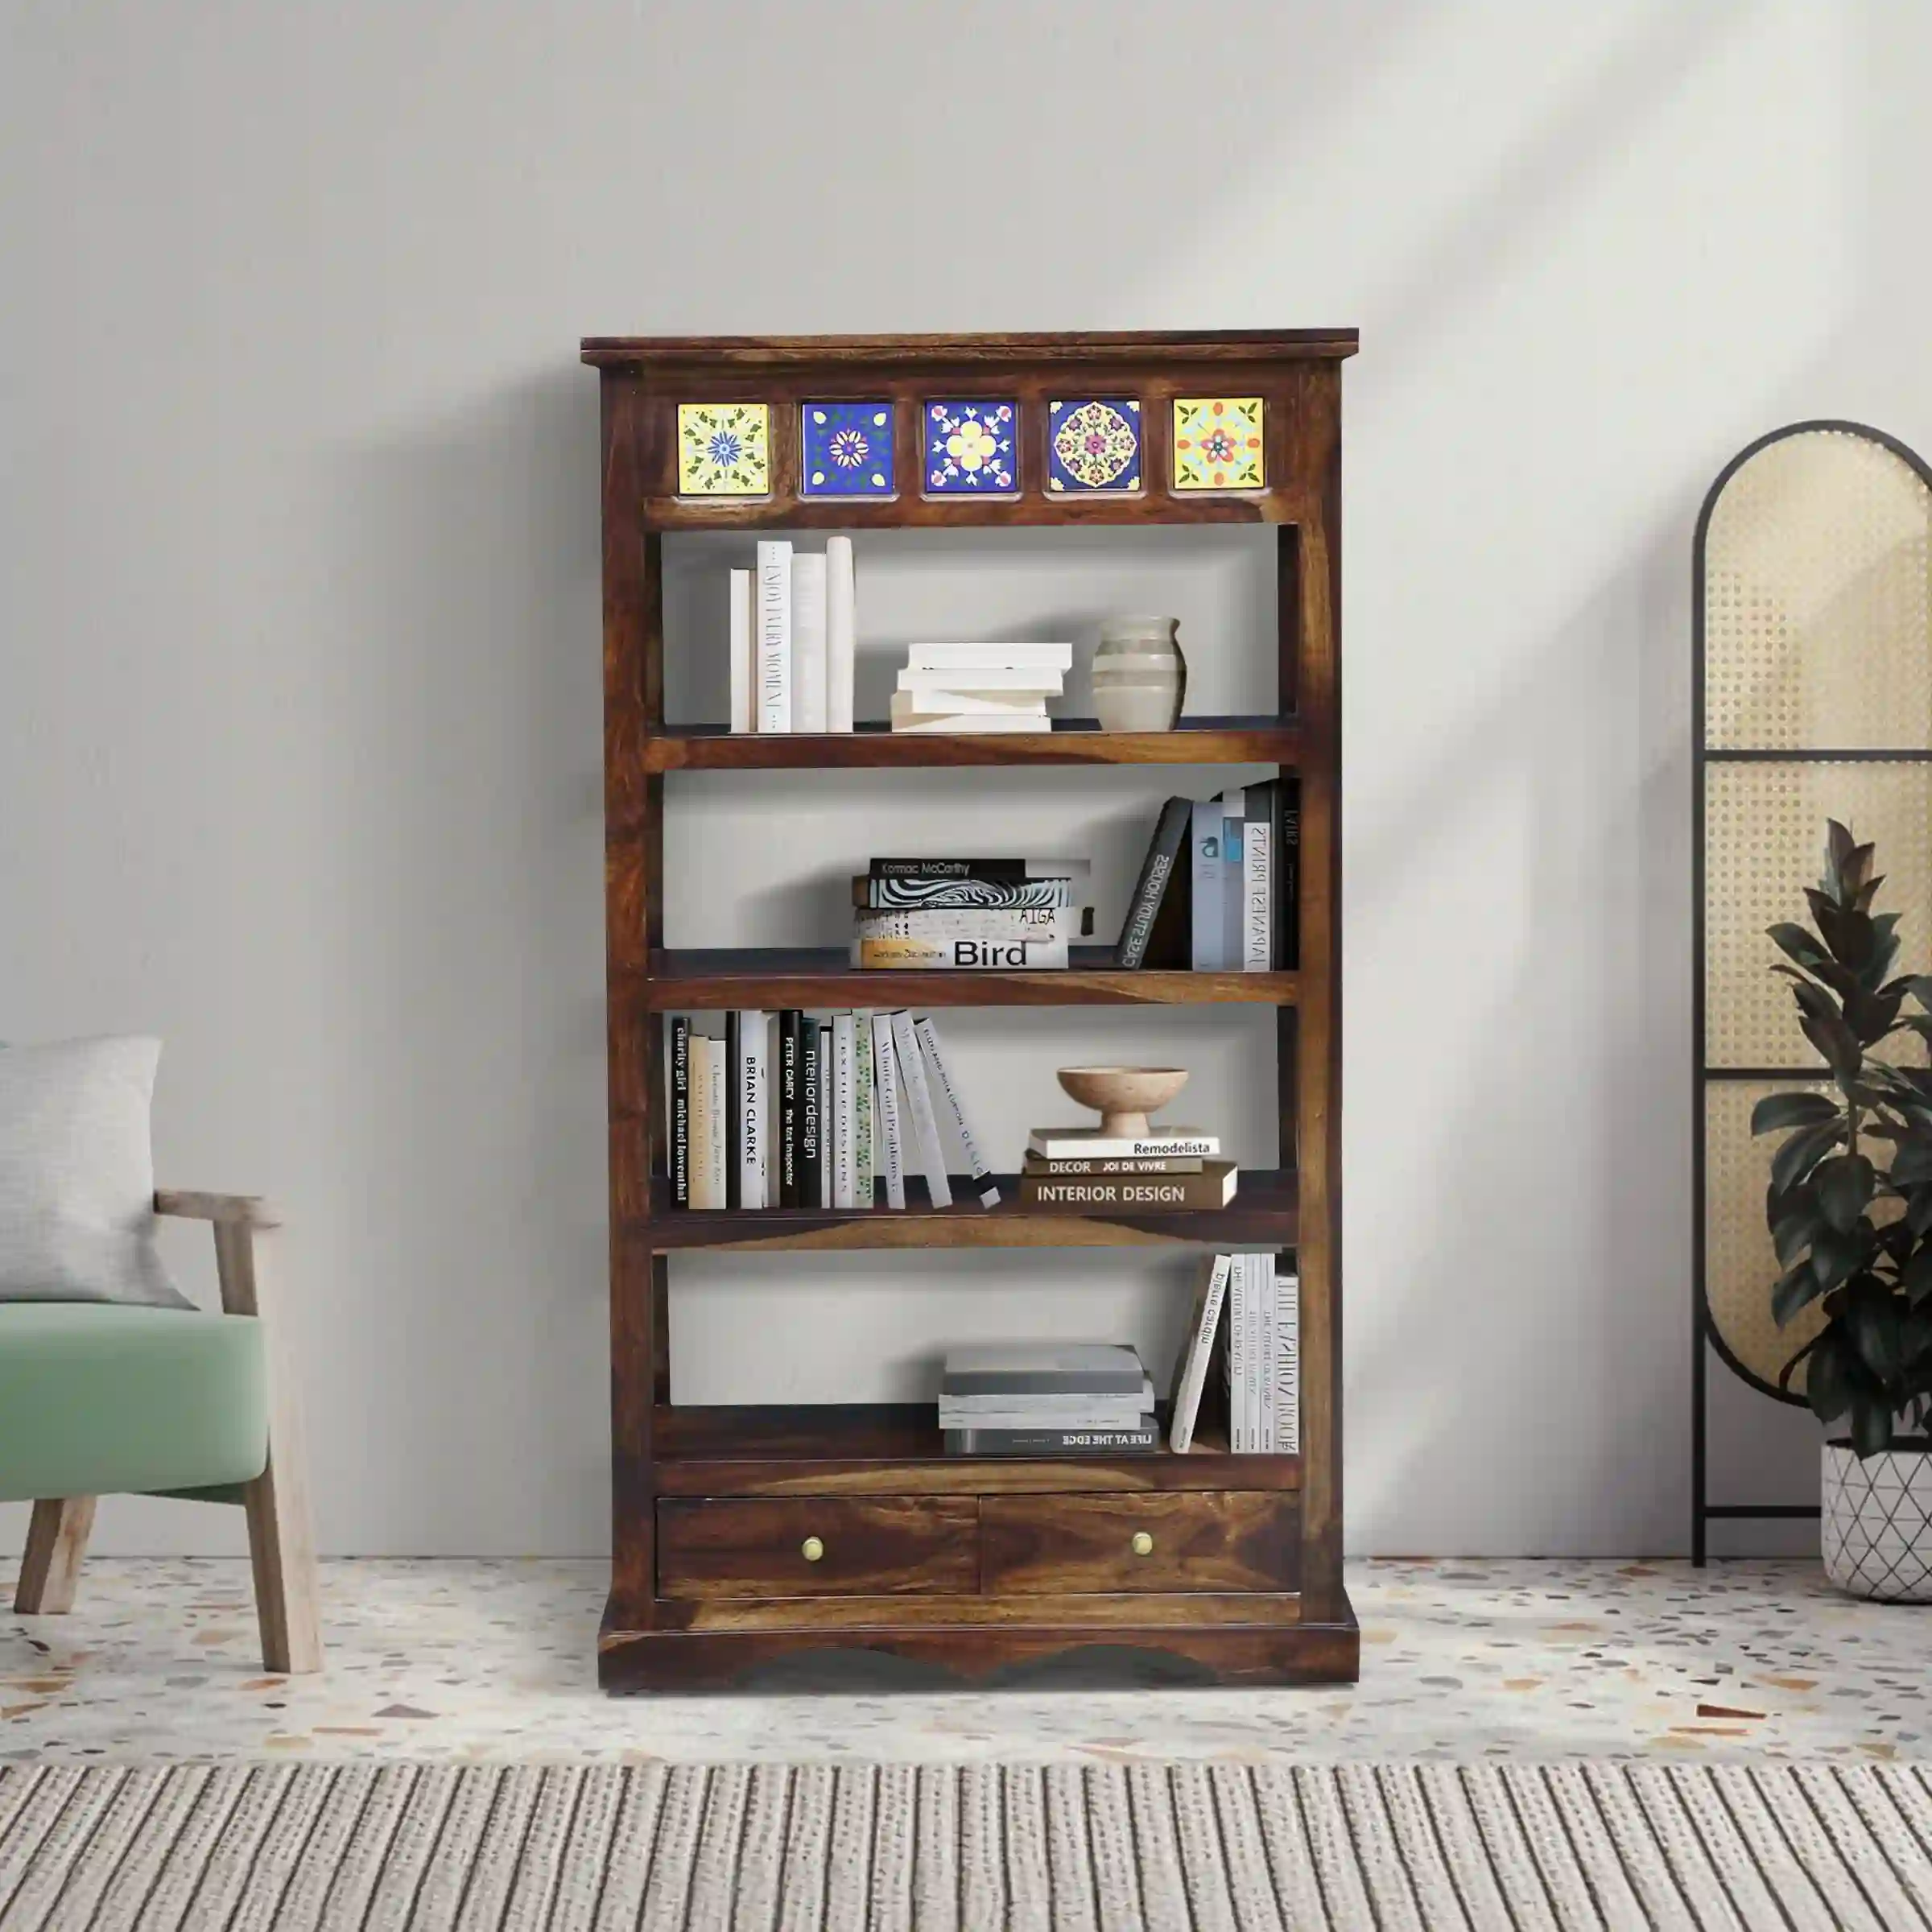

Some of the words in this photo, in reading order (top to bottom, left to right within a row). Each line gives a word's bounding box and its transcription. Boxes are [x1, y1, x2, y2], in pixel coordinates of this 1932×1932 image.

[920, 861, 971, 877] McCarthy
[1020, 907, 1055, 926] AIGA
[954, 941, 1027, 967] Bird
[675, 1027, 687, 1067] charity
[785, 1037, 794, 1067] PETER
[675, 1069, 687, 1091] girl
[745, 1056, 756, 1104] BRIAN
[676, 1099, 687, 1146] michael
[745, 1108, 756, 1166] CLARKE
[1133, 1142, 1210, 1155] Remodelista
[676, 1146, 687, 1201] lowenthal
[1049, 1161, 1092, 1173] DECOR
[1103, 1162, 1120, 1172] JOI
[1121, 1162, 1134, 1171] DE
[1137, 1161, 1166, 1171] VIVRE
[1038, 1186, 1117, 1202] INTERIOR
[1122, 1186, 1186, 1202] DESIGN
